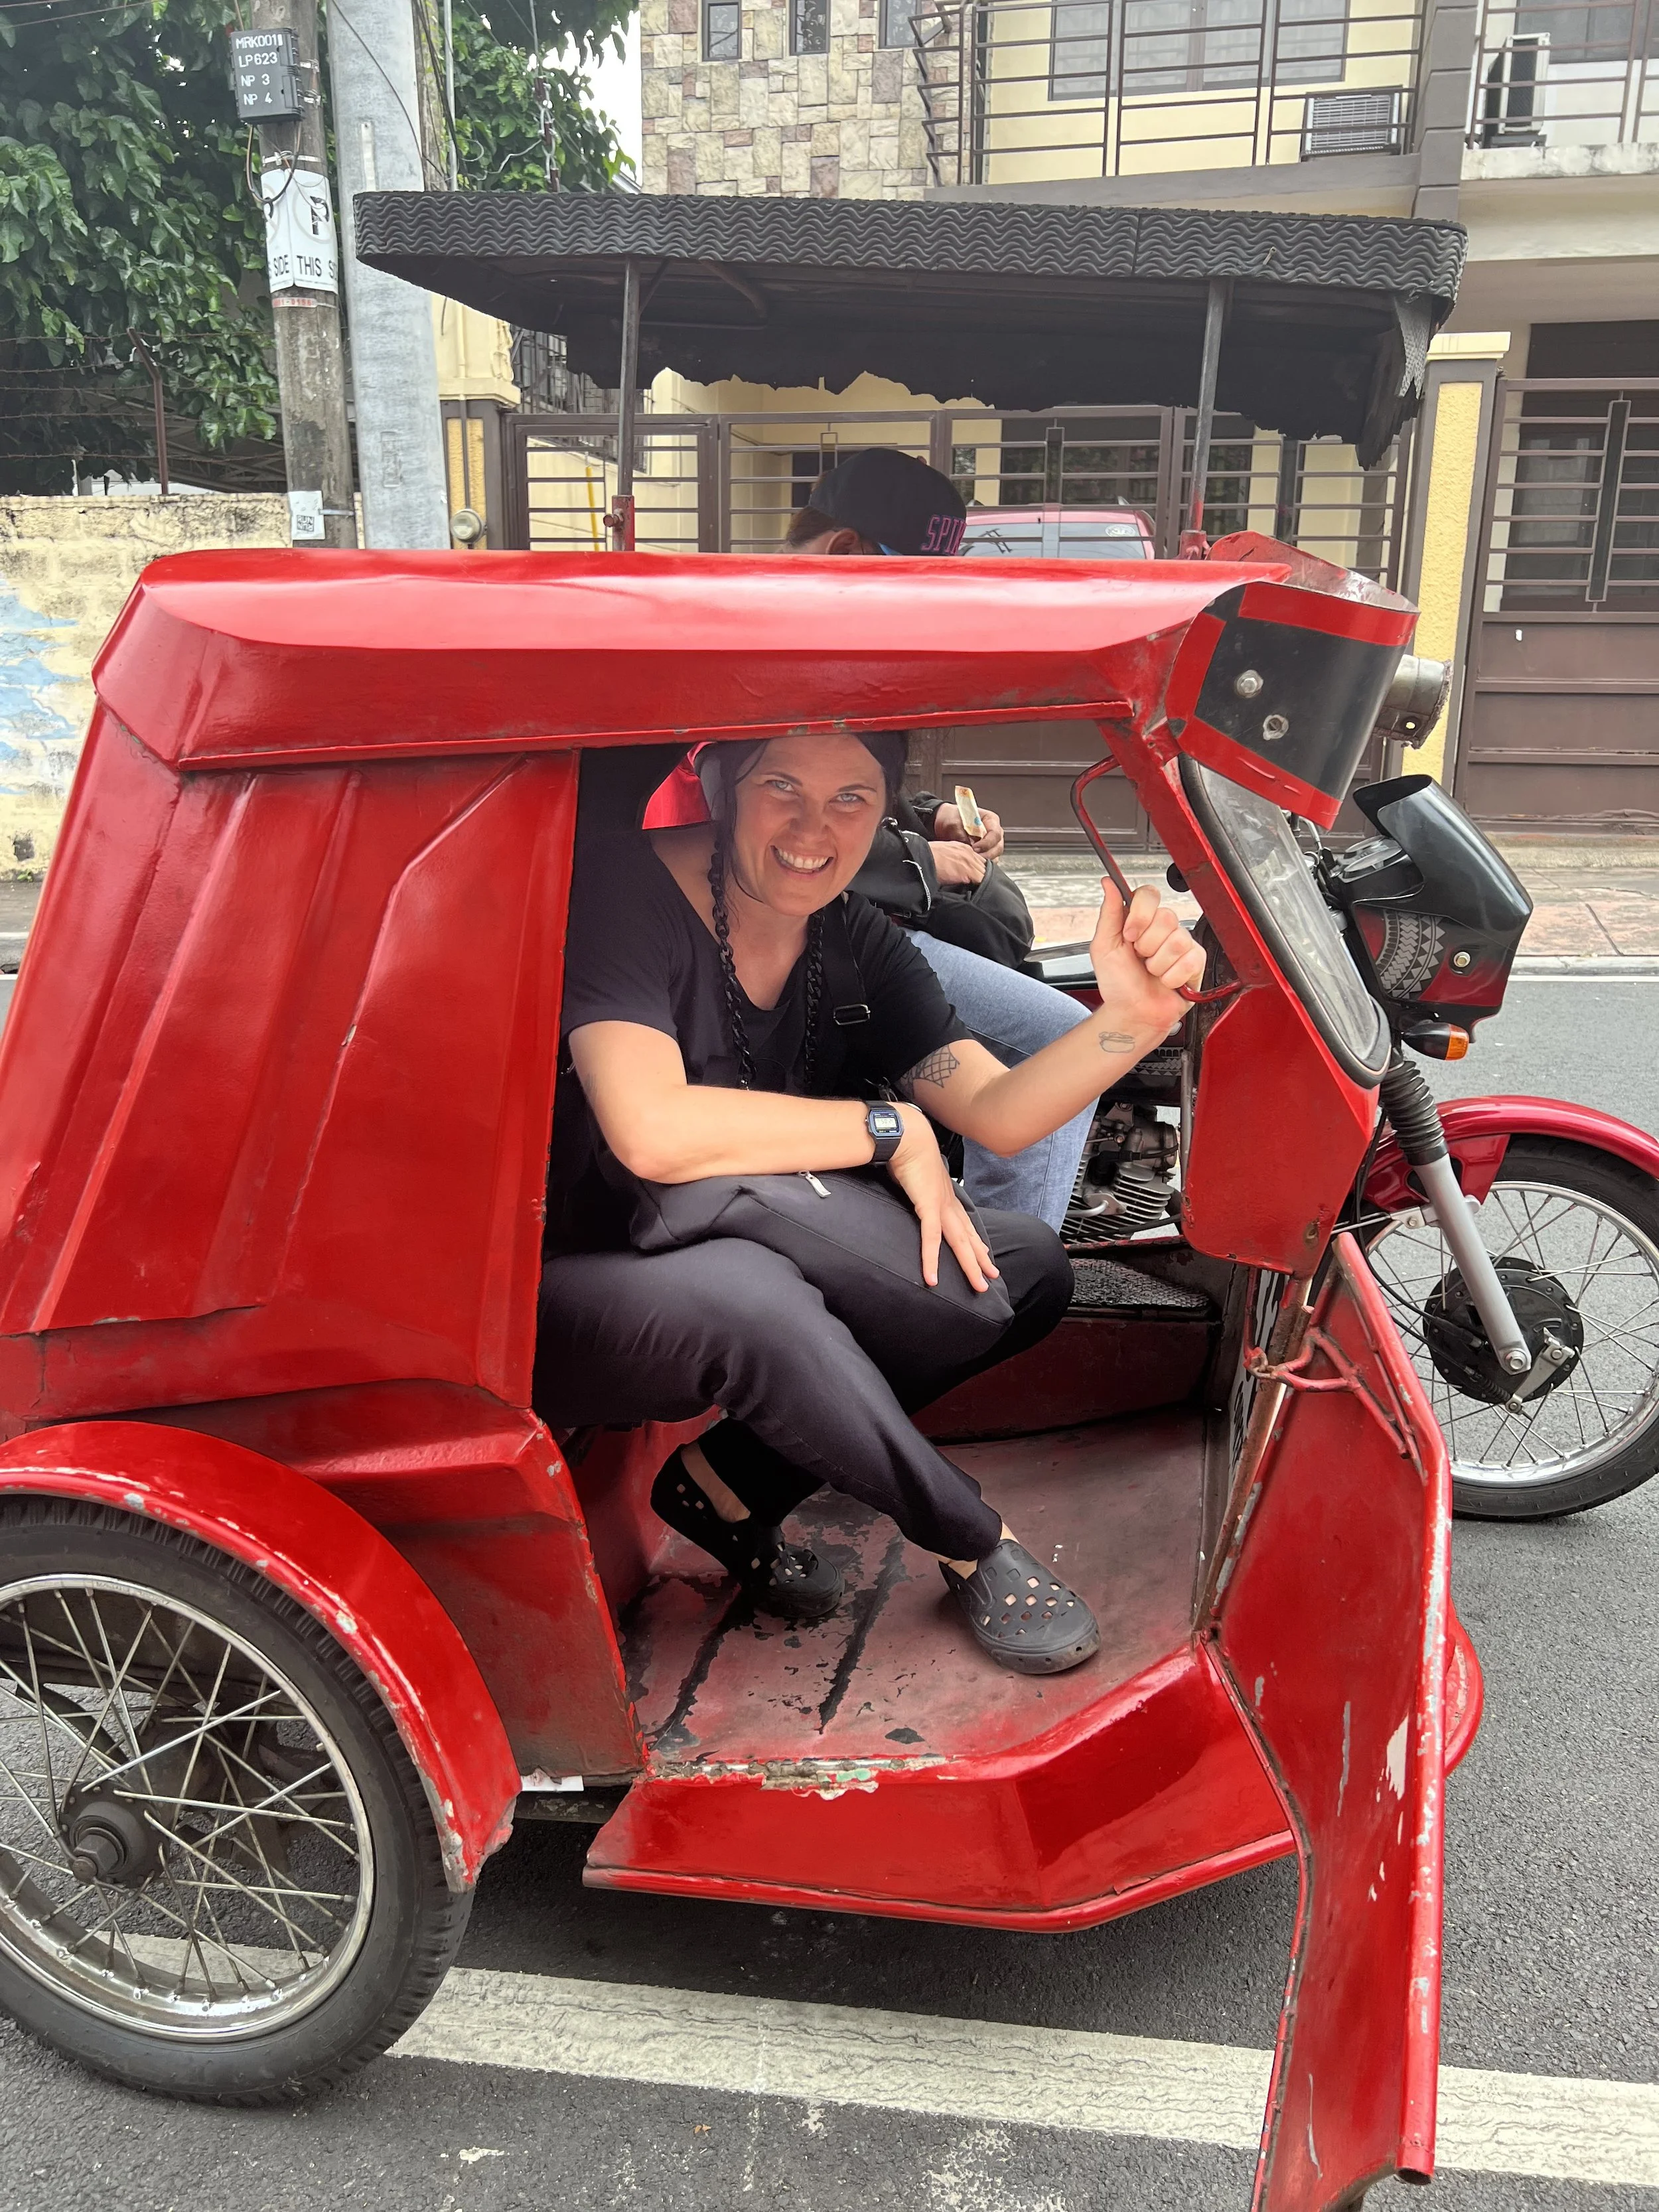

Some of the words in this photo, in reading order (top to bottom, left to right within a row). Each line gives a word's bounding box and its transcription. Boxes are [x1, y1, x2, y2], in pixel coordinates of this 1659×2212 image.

[239, 52, 278, 67] LP623
[241, 75, 255, 87] NP
[261, 74, 270, 86] 3
[244, 94, 257, 106] NP
[265, 92, 273, 104] 4
[273, 255, 289, 277] SIDE
[297, 255, 322, 277] THIS
